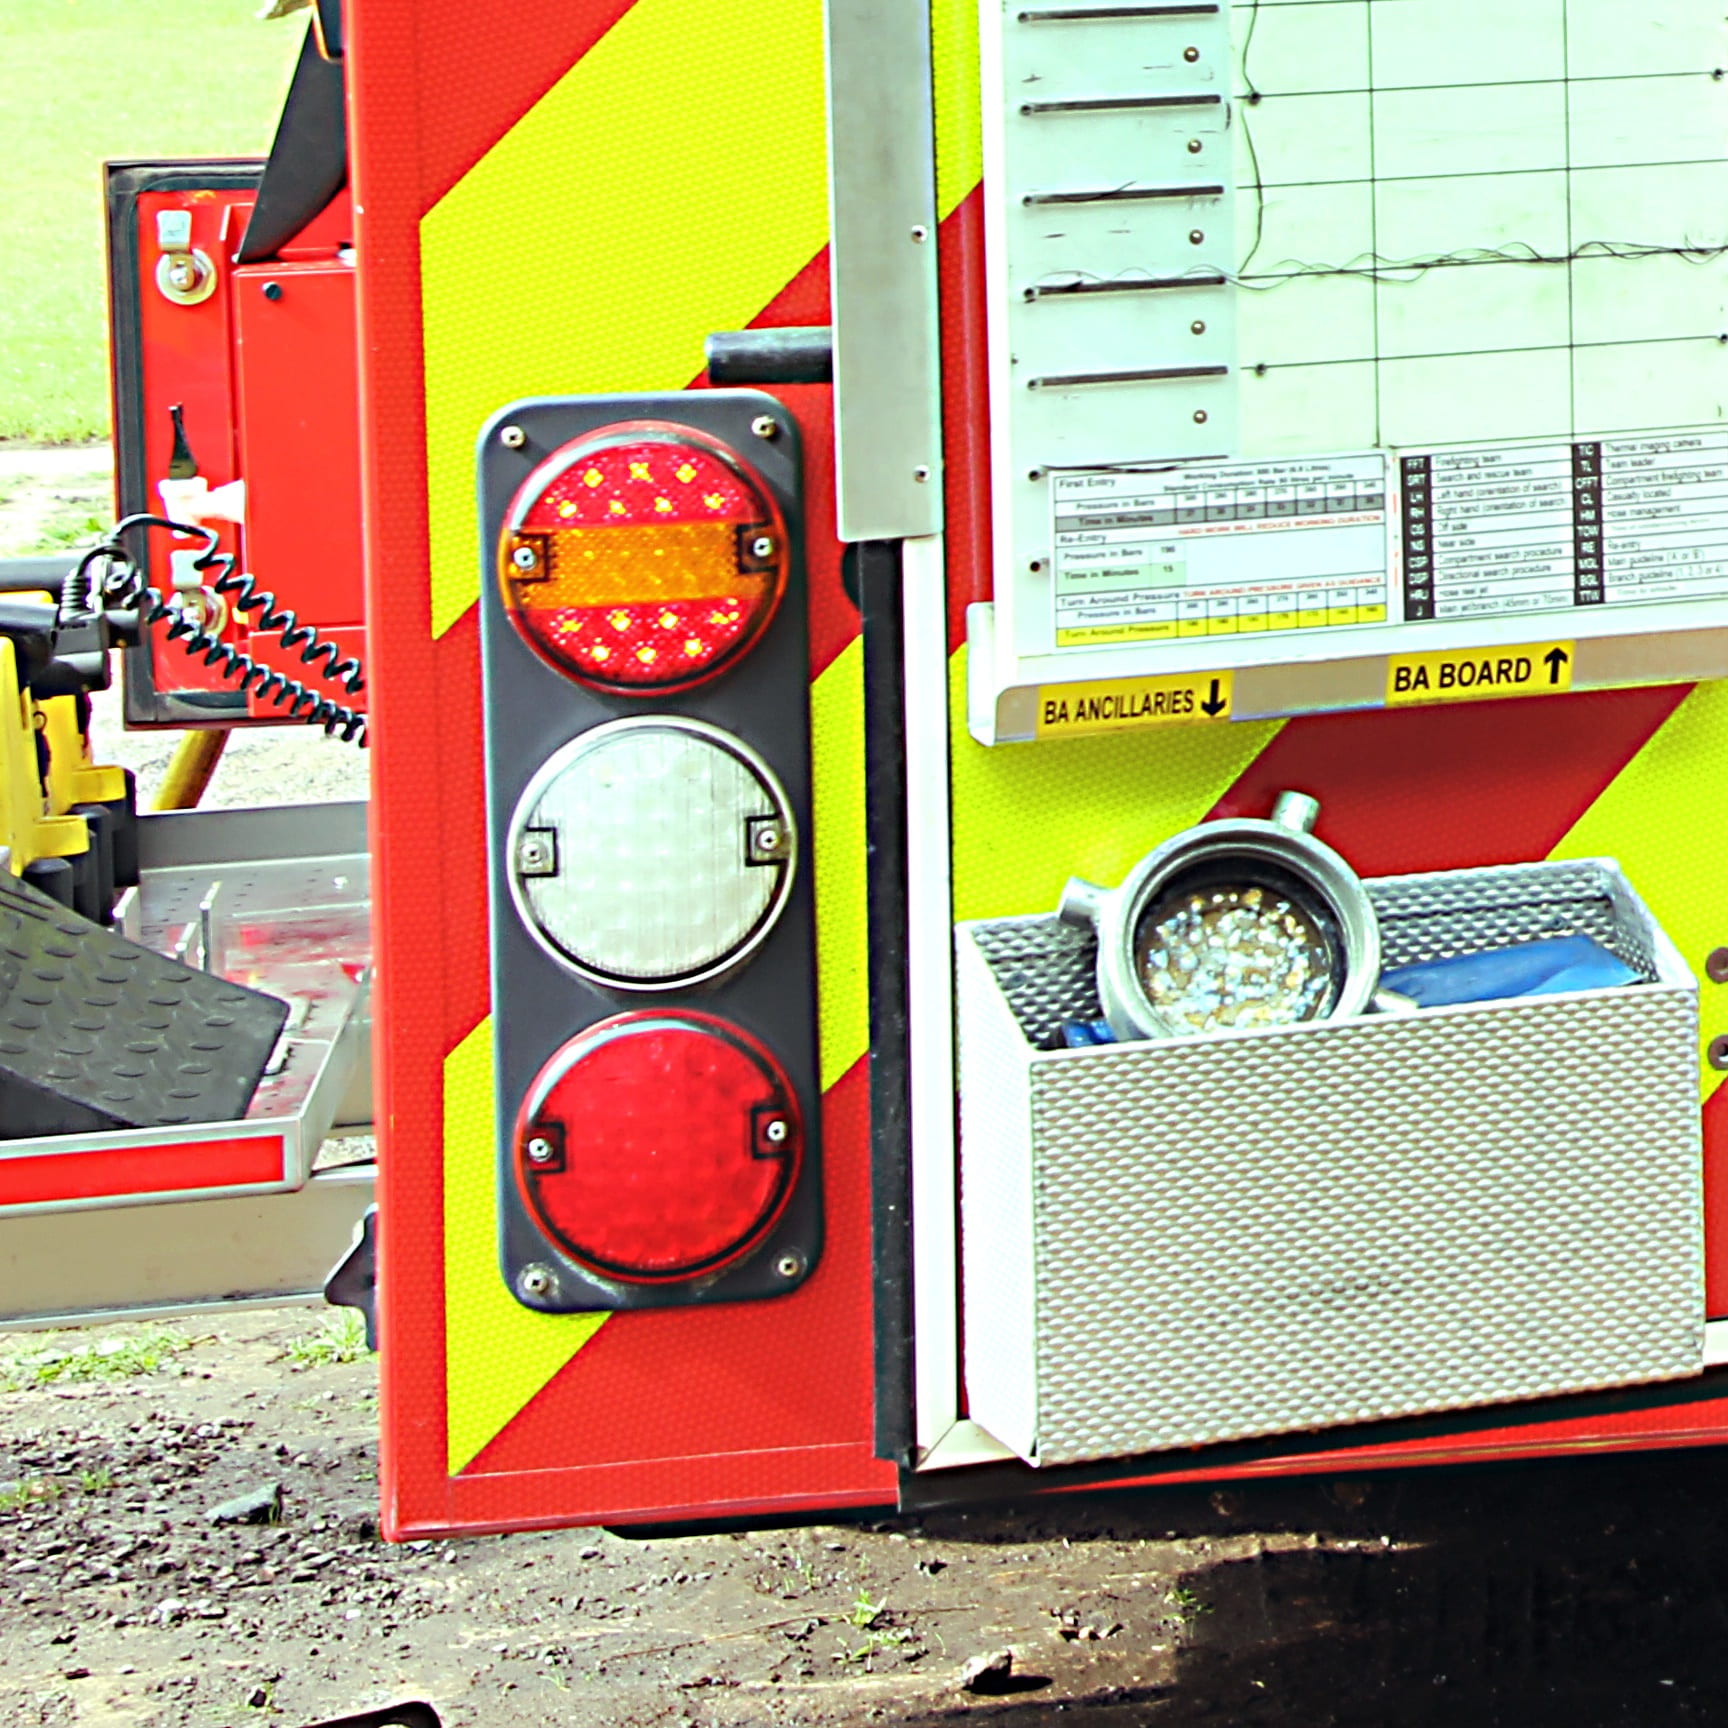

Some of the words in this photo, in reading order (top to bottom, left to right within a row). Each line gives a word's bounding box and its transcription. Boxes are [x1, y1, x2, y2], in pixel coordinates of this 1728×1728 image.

[1059, 479, 1084, 488] First
[1088, 477, 1115, 487] Entry
[1060, 534, 1106, 544] Re-Entry
[1061, 597, 1085, 607] Turn
[1090, 595, 1128, 604] Around
[1133, 591, 1180, 600] Pressure
[1395, 665, 1429, 692] BA
[1439, 657, 1532, 688] BOARD
[1044, 699, 1068, 724] BA
[1076, 688, 1194, 720] ANCILLARIES
